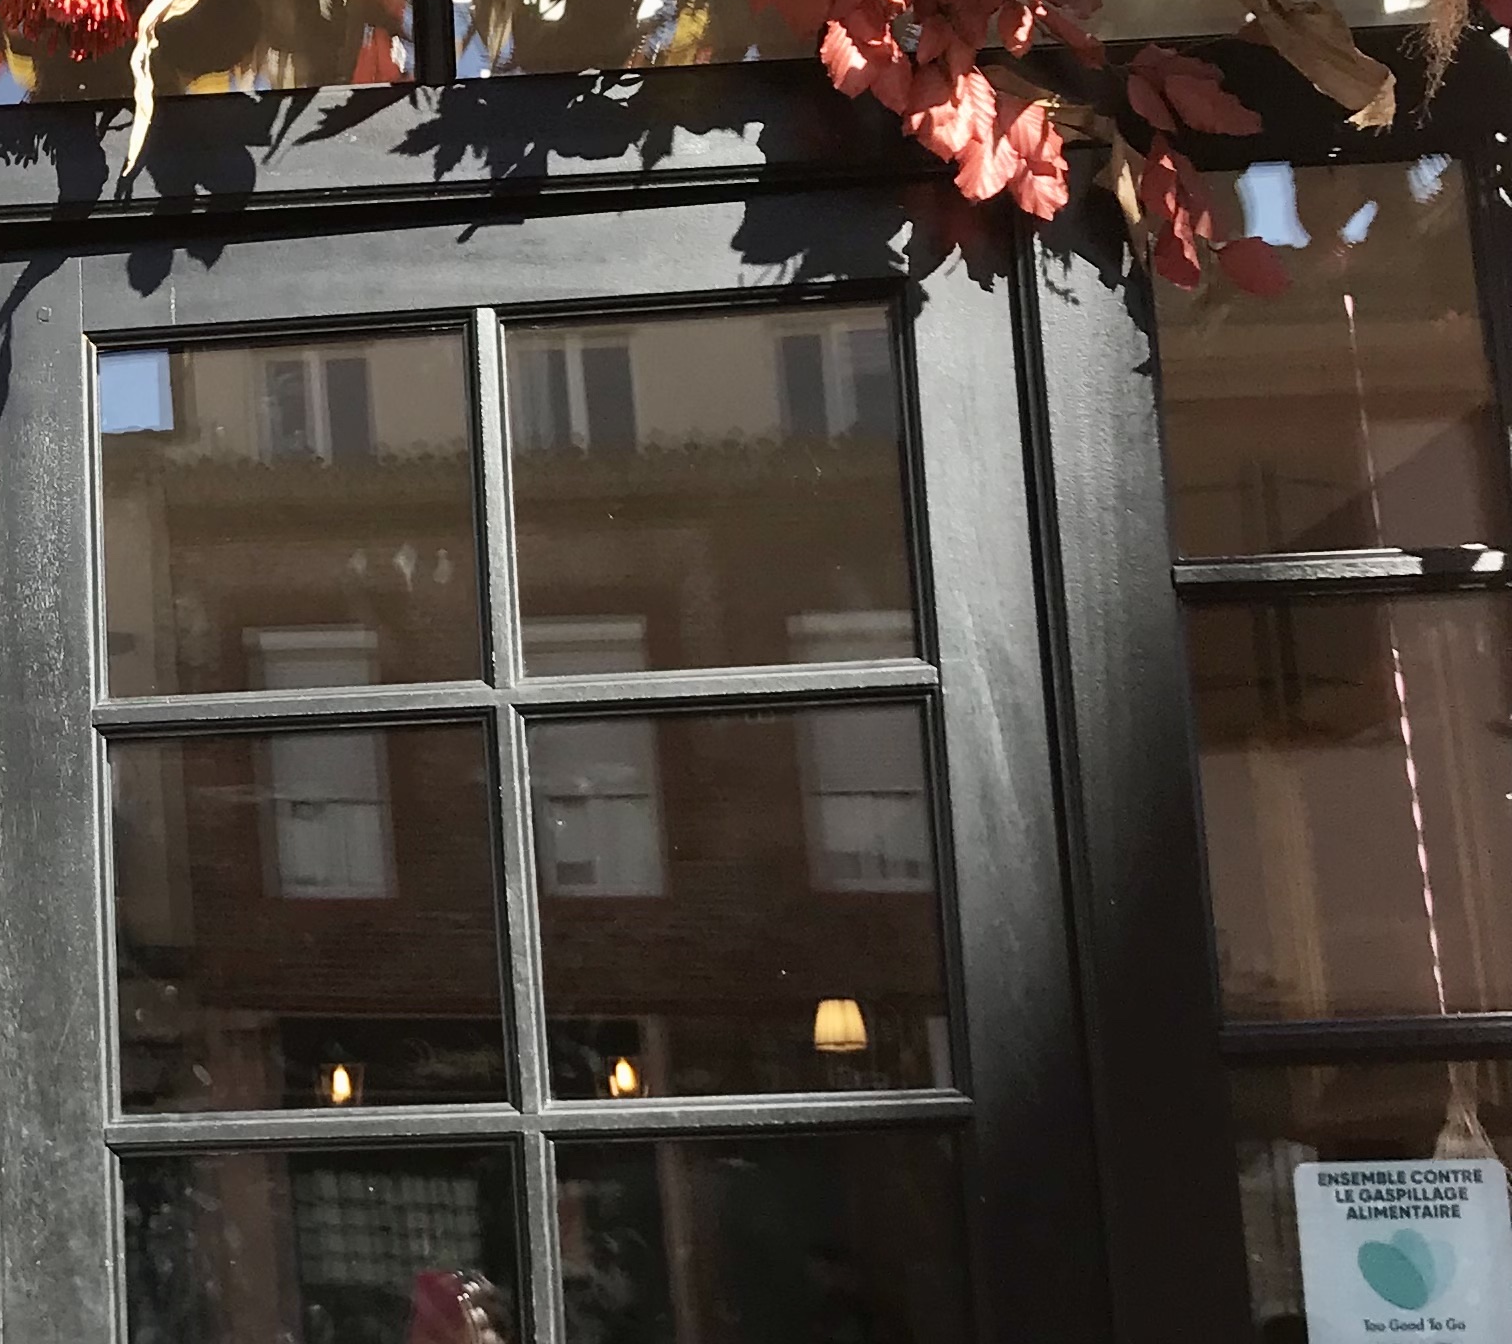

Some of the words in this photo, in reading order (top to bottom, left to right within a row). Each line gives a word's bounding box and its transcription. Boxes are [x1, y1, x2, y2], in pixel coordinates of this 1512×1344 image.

[1317, 1170, 1407, 1187] ENSEMBLE
[1410, 1168, 1484, 1185] CONTRE
[1334, 1188, 1355, 1203] LE
[1358, 1186, 1469, 1203] GASPILLAGE
[1346, 1203, 1462, 1220] ALIMENTAIRE
[1363, 1318, 1386, 1332] Too
[1389, 1317, 1425, 1332] Good
[1428, 1317, 1443, 1331] To
[1446, 1317, 1467, 1331] Go
